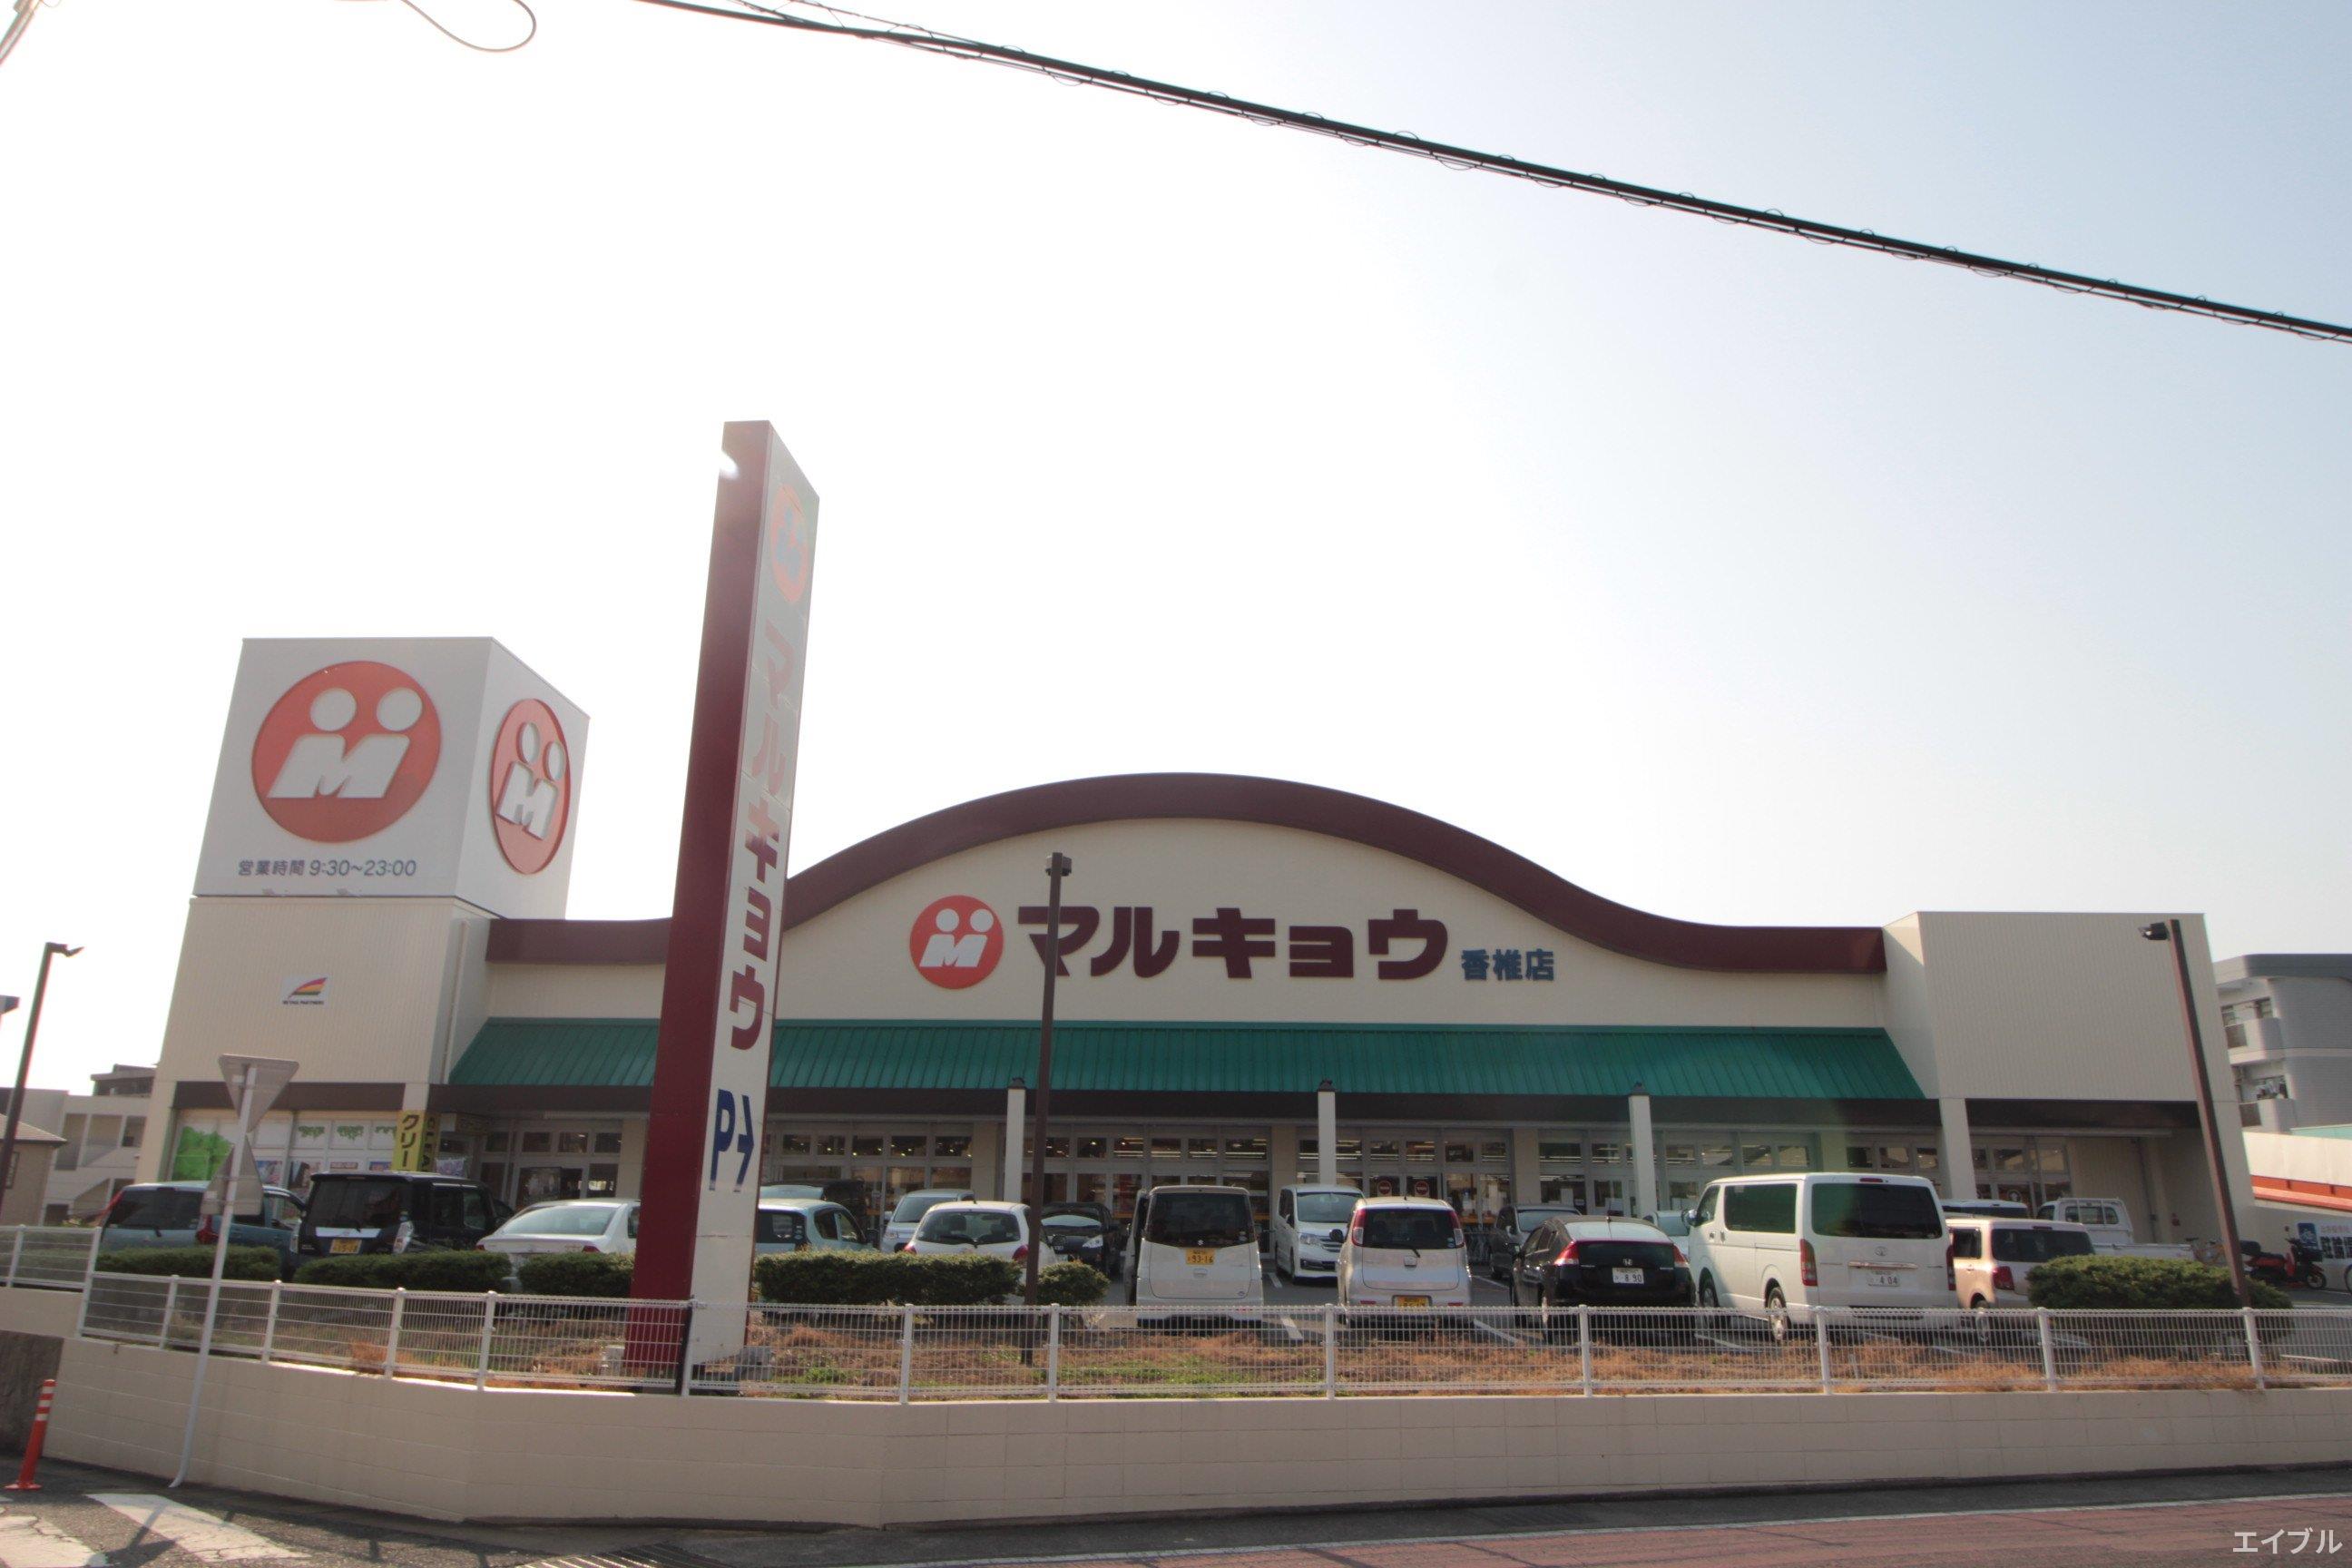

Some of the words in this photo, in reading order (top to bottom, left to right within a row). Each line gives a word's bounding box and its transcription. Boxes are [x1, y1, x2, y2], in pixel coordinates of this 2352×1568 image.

[239, 859, 306, 876] 営業時間
[730, 619, 793, 1051] マルキョウ
[1018, 906, 1448, 980] マルキョウ
[1461, 948, 1554, 981] 香椎店
[709, 1089, 736, 1191] P
